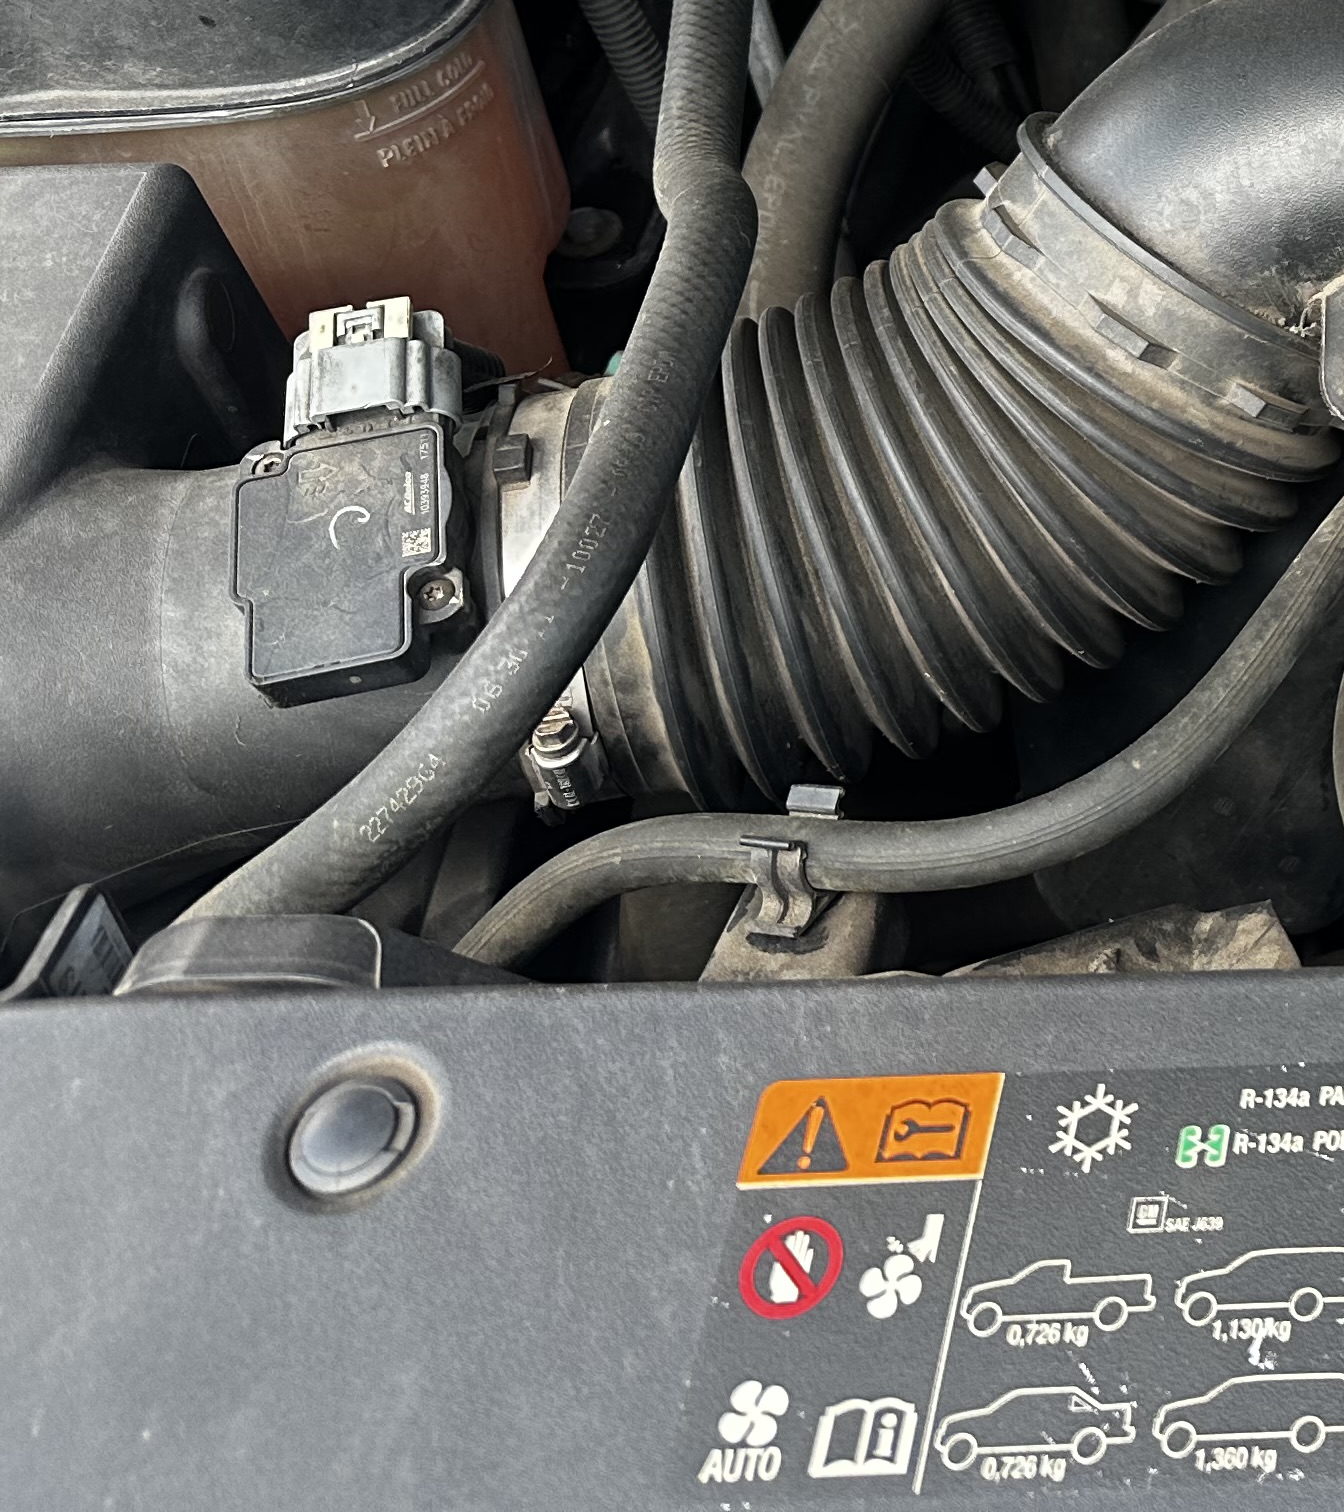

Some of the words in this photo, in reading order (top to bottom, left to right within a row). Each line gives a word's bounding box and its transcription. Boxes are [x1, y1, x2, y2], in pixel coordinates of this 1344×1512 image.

[1240, 1087, 1310, 1110] R-134a
[1233, 1132, 1304, 1155] R-134a
[1006, 1322, 1061, 1348] 0,726
[1064, 1322, 1089, 1348] kg
[697, 1446, 782, 1484] AUTO
[980, 1455, 1037, 1481] 0,726
[1041, 1454, 1067, 1482] kg
[1195, 1447, 1249, 1473] 1,360
[1250, 1446, 1277, 1473] kg
